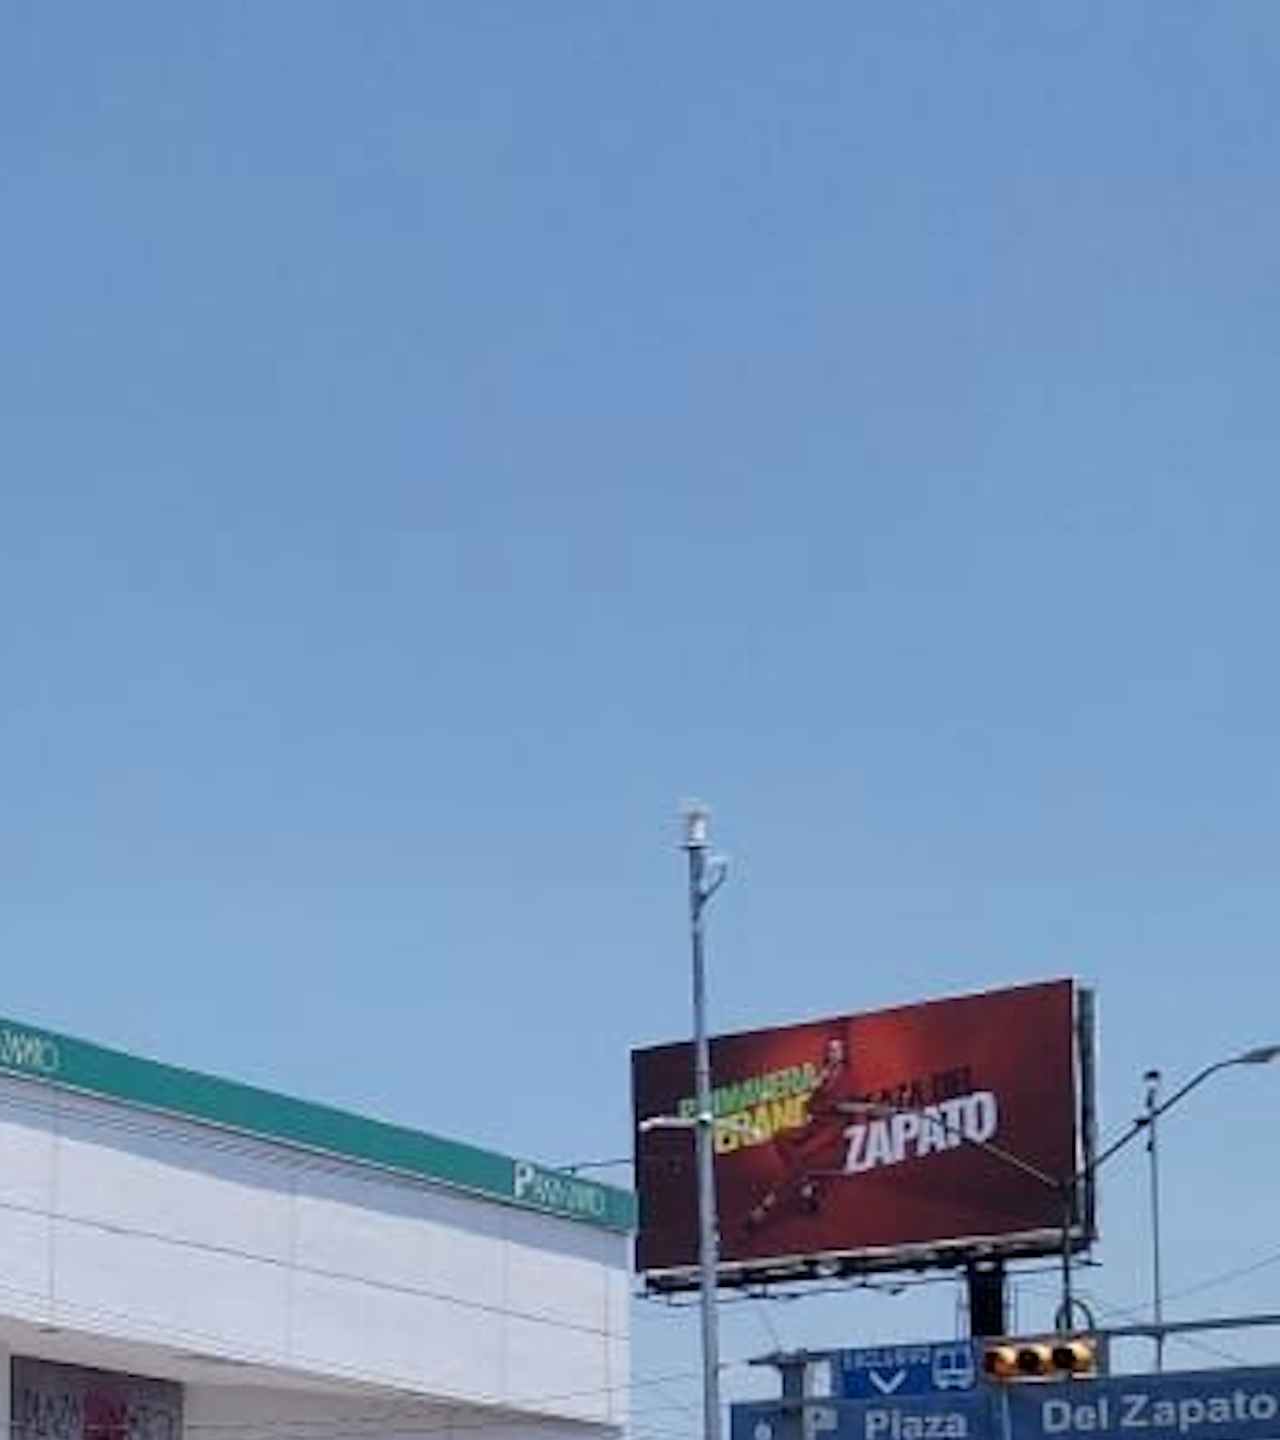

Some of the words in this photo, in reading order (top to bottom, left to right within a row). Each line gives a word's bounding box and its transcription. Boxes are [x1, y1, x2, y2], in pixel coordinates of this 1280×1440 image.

[842, 1091, 998, 1175] ZAPATO
[1042, 1397, 1109, 1433] Del
[1121, 1390, 1278, 1433] Zapato
